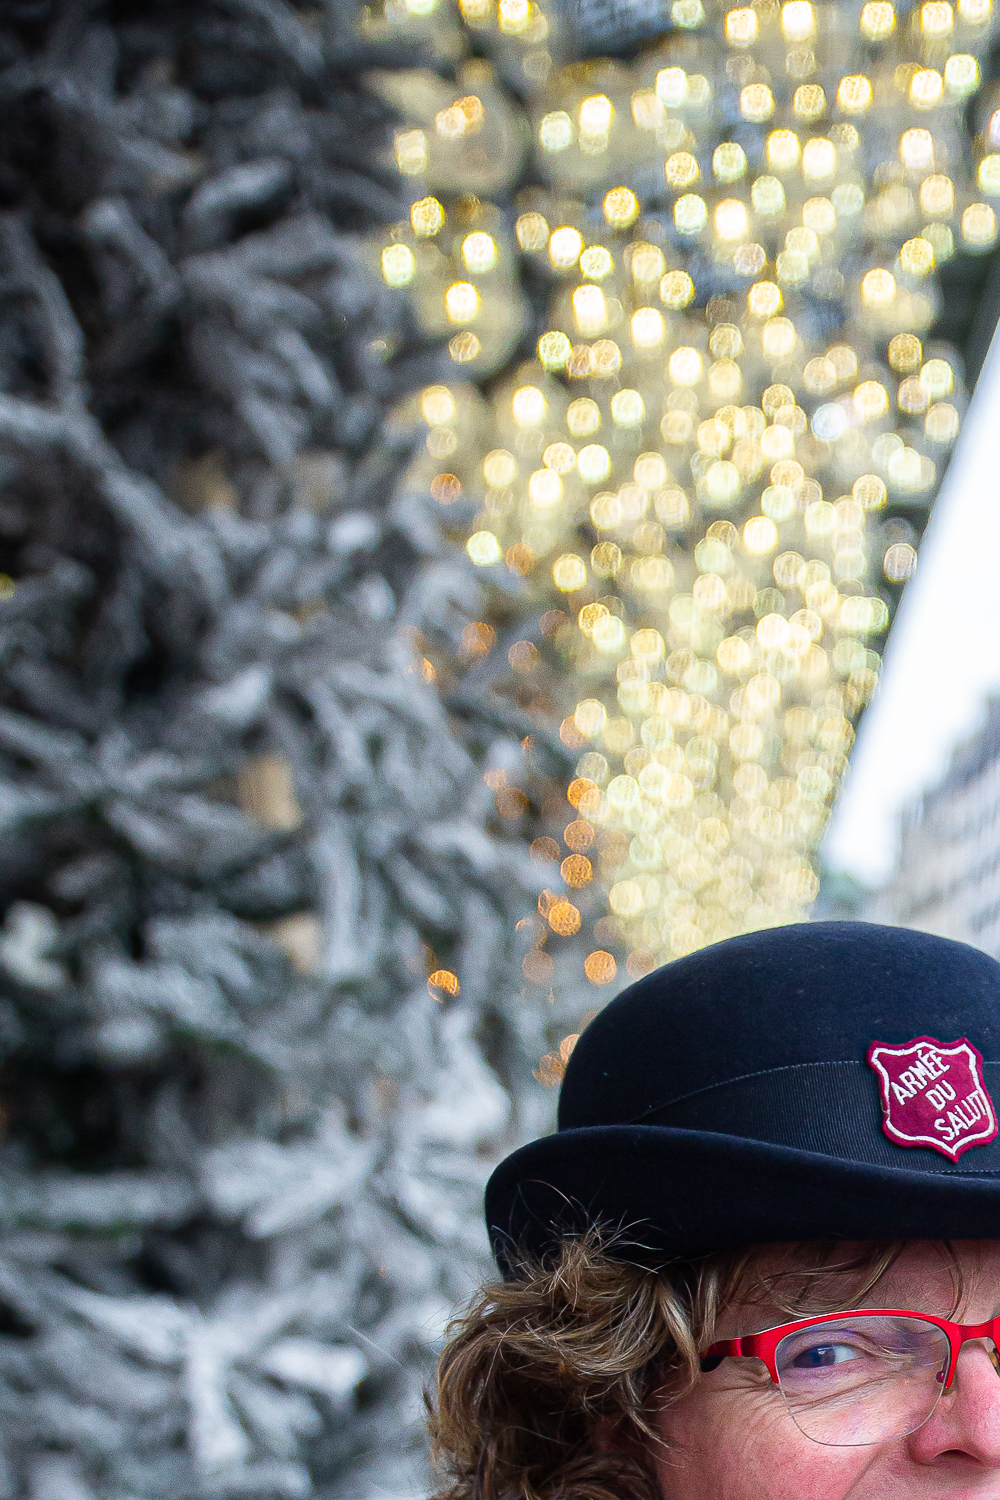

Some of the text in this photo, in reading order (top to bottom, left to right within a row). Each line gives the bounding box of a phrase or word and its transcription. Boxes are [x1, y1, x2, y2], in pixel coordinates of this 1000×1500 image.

[891, 1050, 950, 1105] ARMÉE
[925, 1080, 957, 1111] DU
[934, 1090, 987, 1141] SALUT
